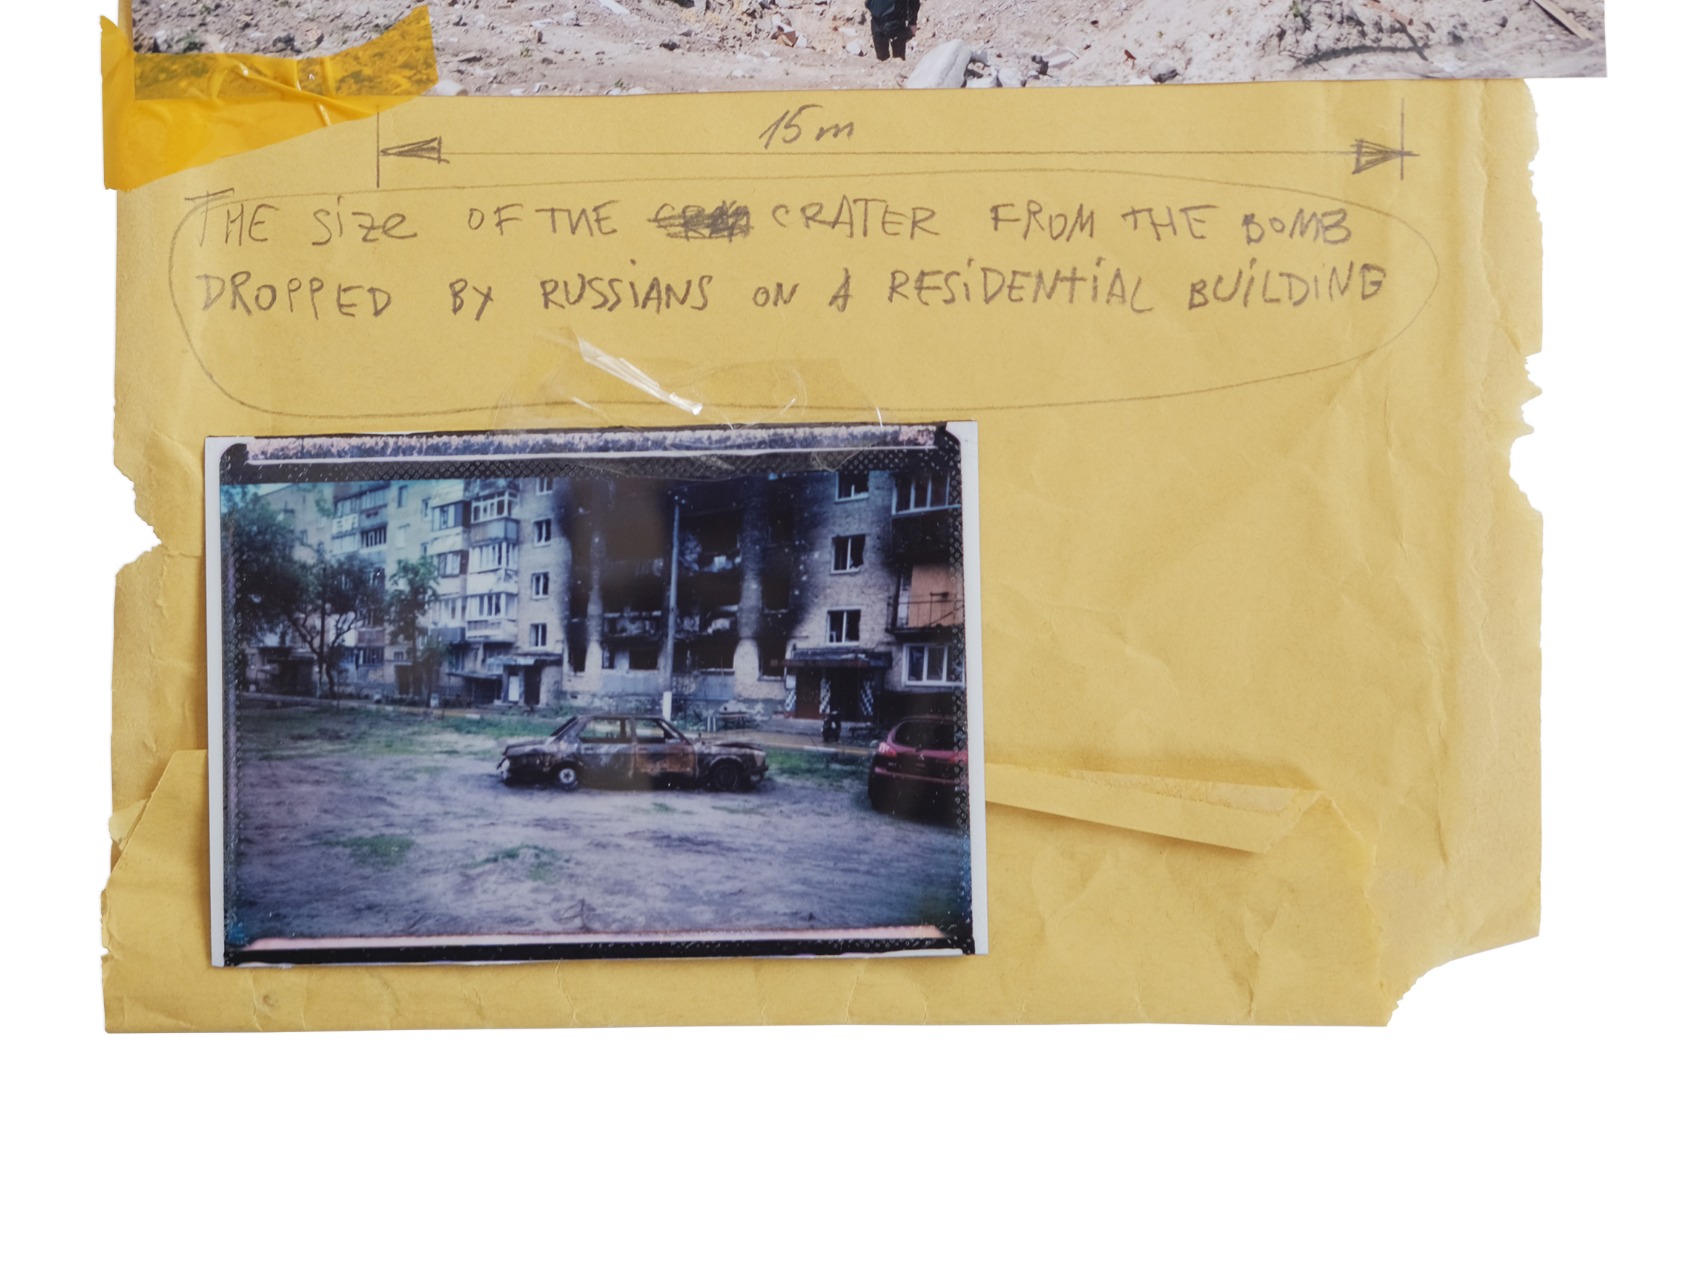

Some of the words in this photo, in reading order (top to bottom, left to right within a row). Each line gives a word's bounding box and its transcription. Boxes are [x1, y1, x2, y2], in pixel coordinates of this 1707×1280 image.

[183, 188, 281, 247] THE
[468, 202, 524, 232] OF
[535, 200, 621, 236] THE
[772, 195, 939, 238] CRATER
[990, 200, 1097, 242] FROM
[1121, 204, 1220, 242] THE
[1241, 206, 1351, 245] BOMB
[196, 270, 392, 319] DROPPED
[449, 279, 495, 321] BY
[752, 282, 799, 308] ON
[828, 267, 853, 313] A
